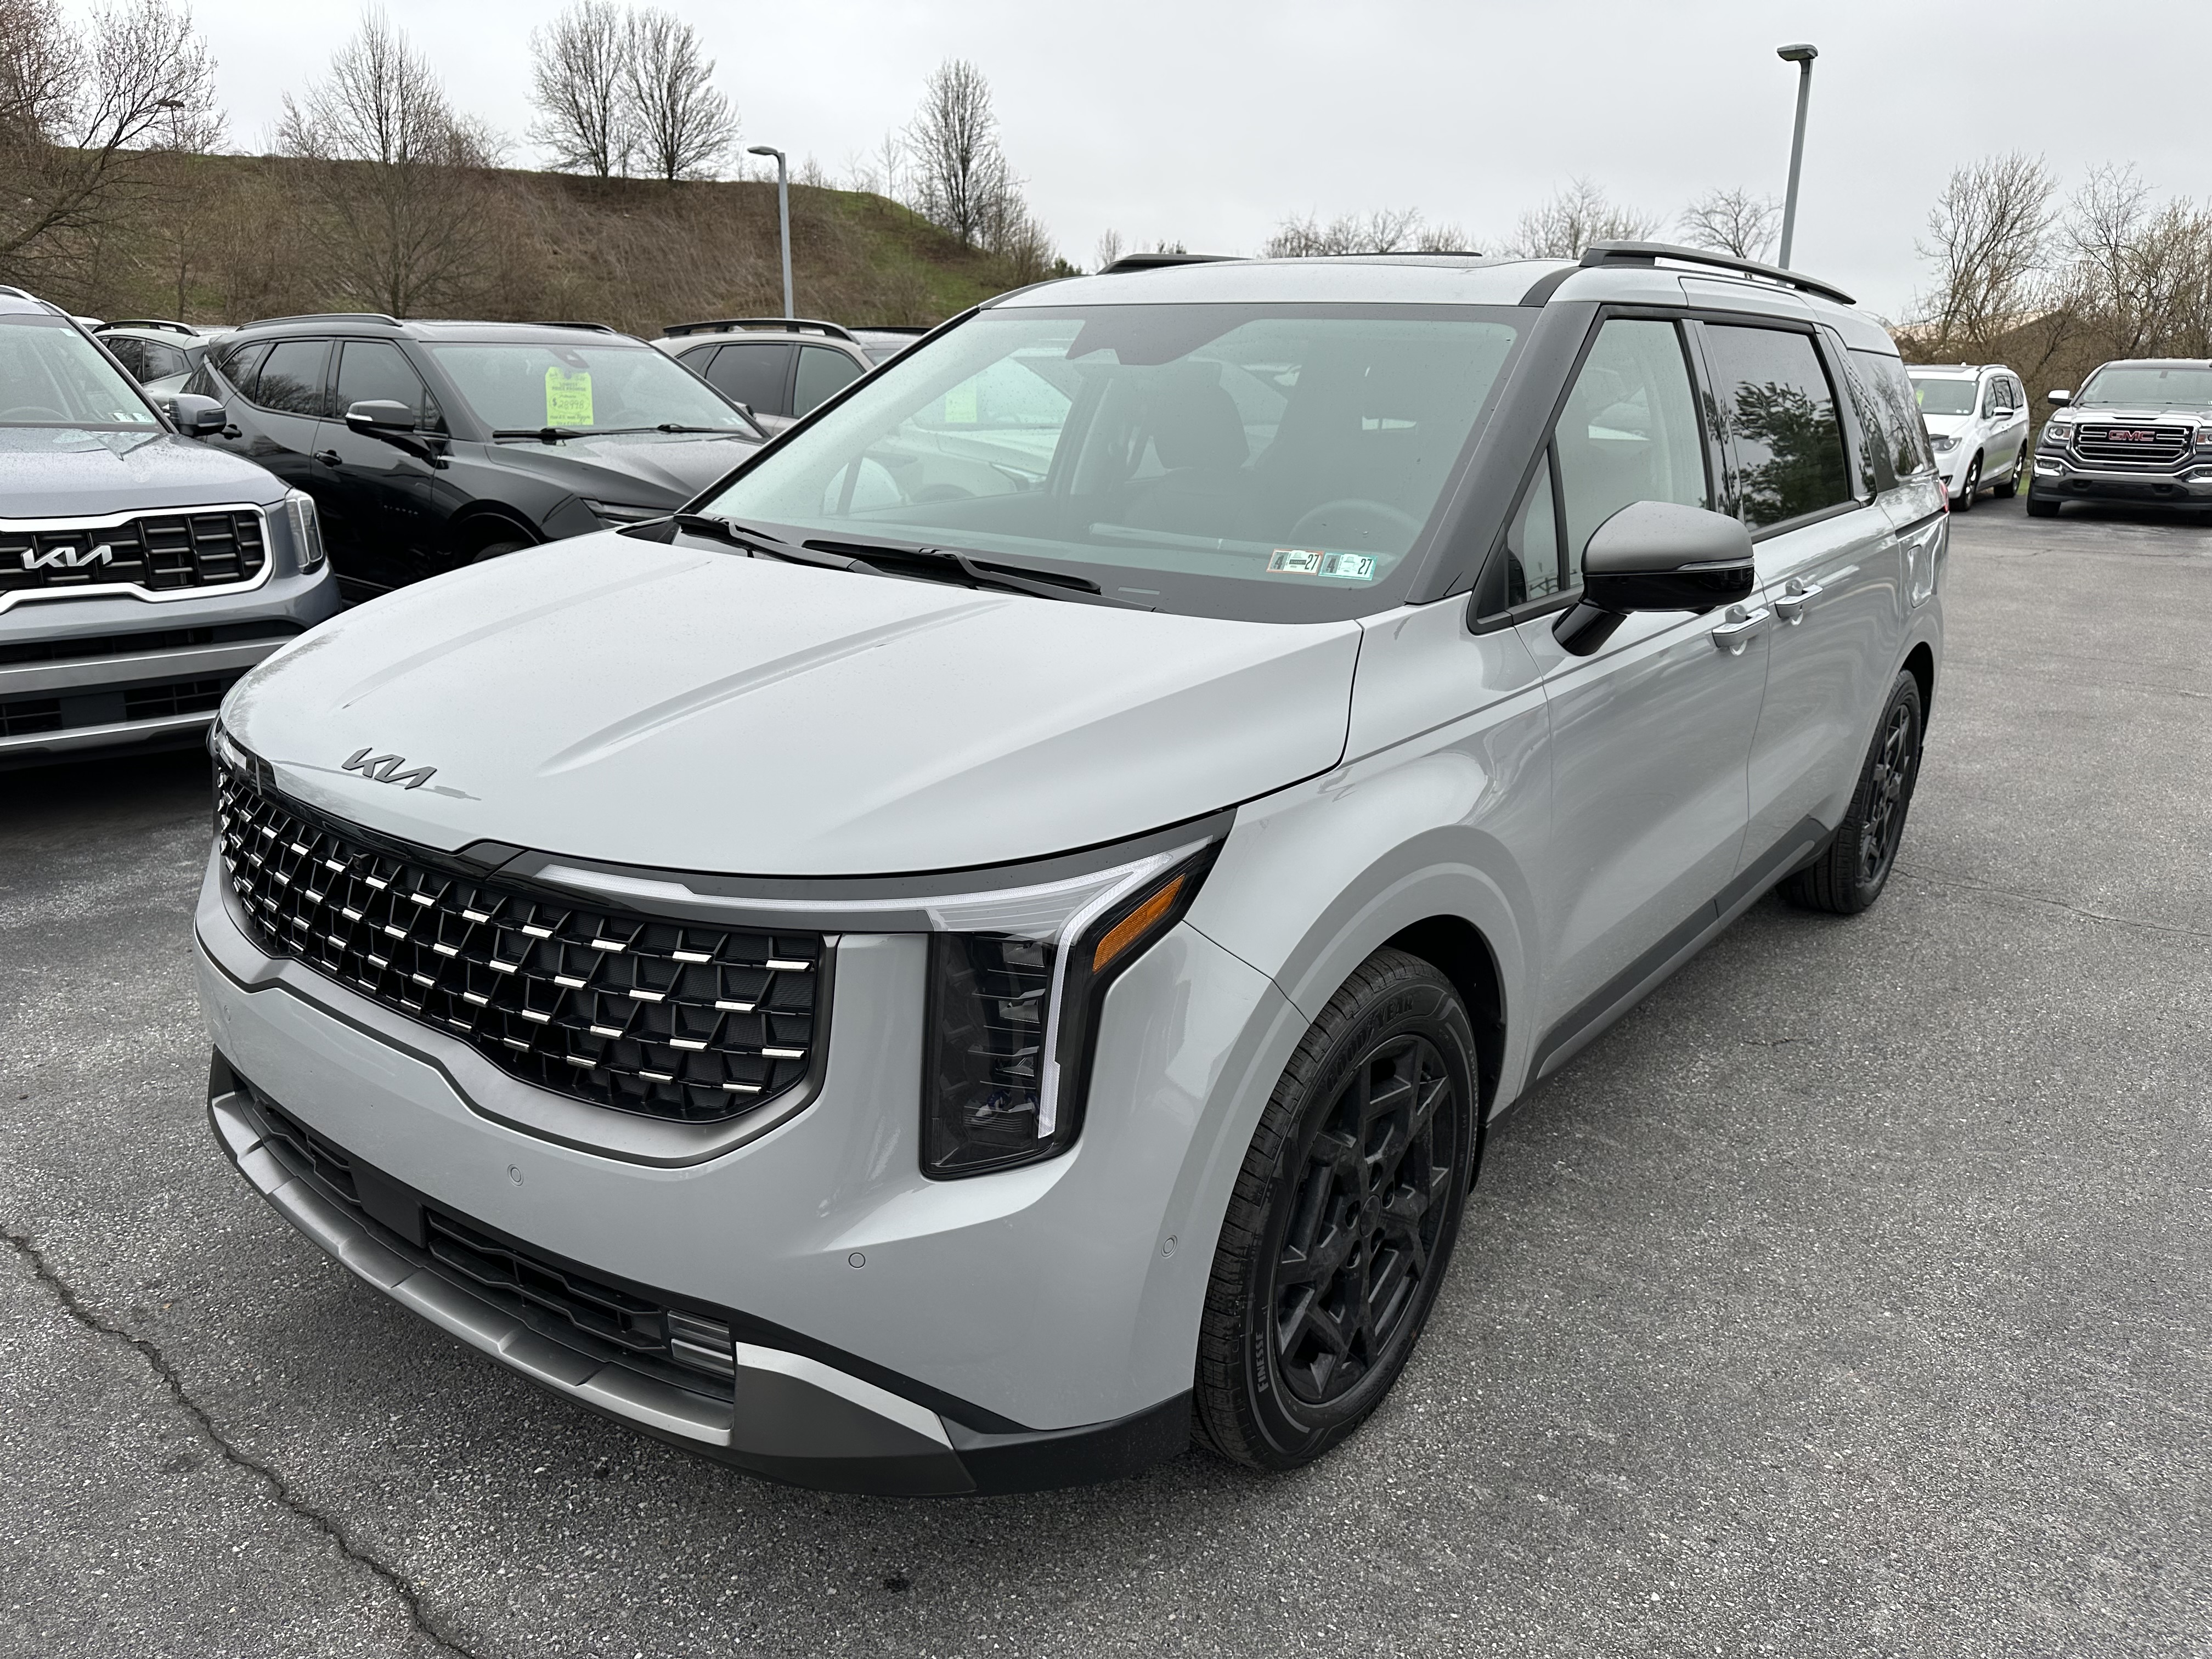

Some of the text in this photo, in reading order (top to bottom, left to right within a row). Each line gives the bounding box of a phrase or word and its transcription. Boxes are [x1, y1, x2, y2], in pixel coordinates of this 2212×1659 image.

[2108, 430, 2155, 442] GMC
[21, 544, 113, 569] KIA
[1274, 555, 1284, 569] 4
[1304, 554, 1319, 571] 27
[1327, 557, 1336, 573] 4
[1357, 558, 1373, 575] 27
[341, 747, 437, 790] KIA
[1325, 992, 1414, 1093] GOODYEAR
[1255, 1330, 1269, 1392] FINESSE
